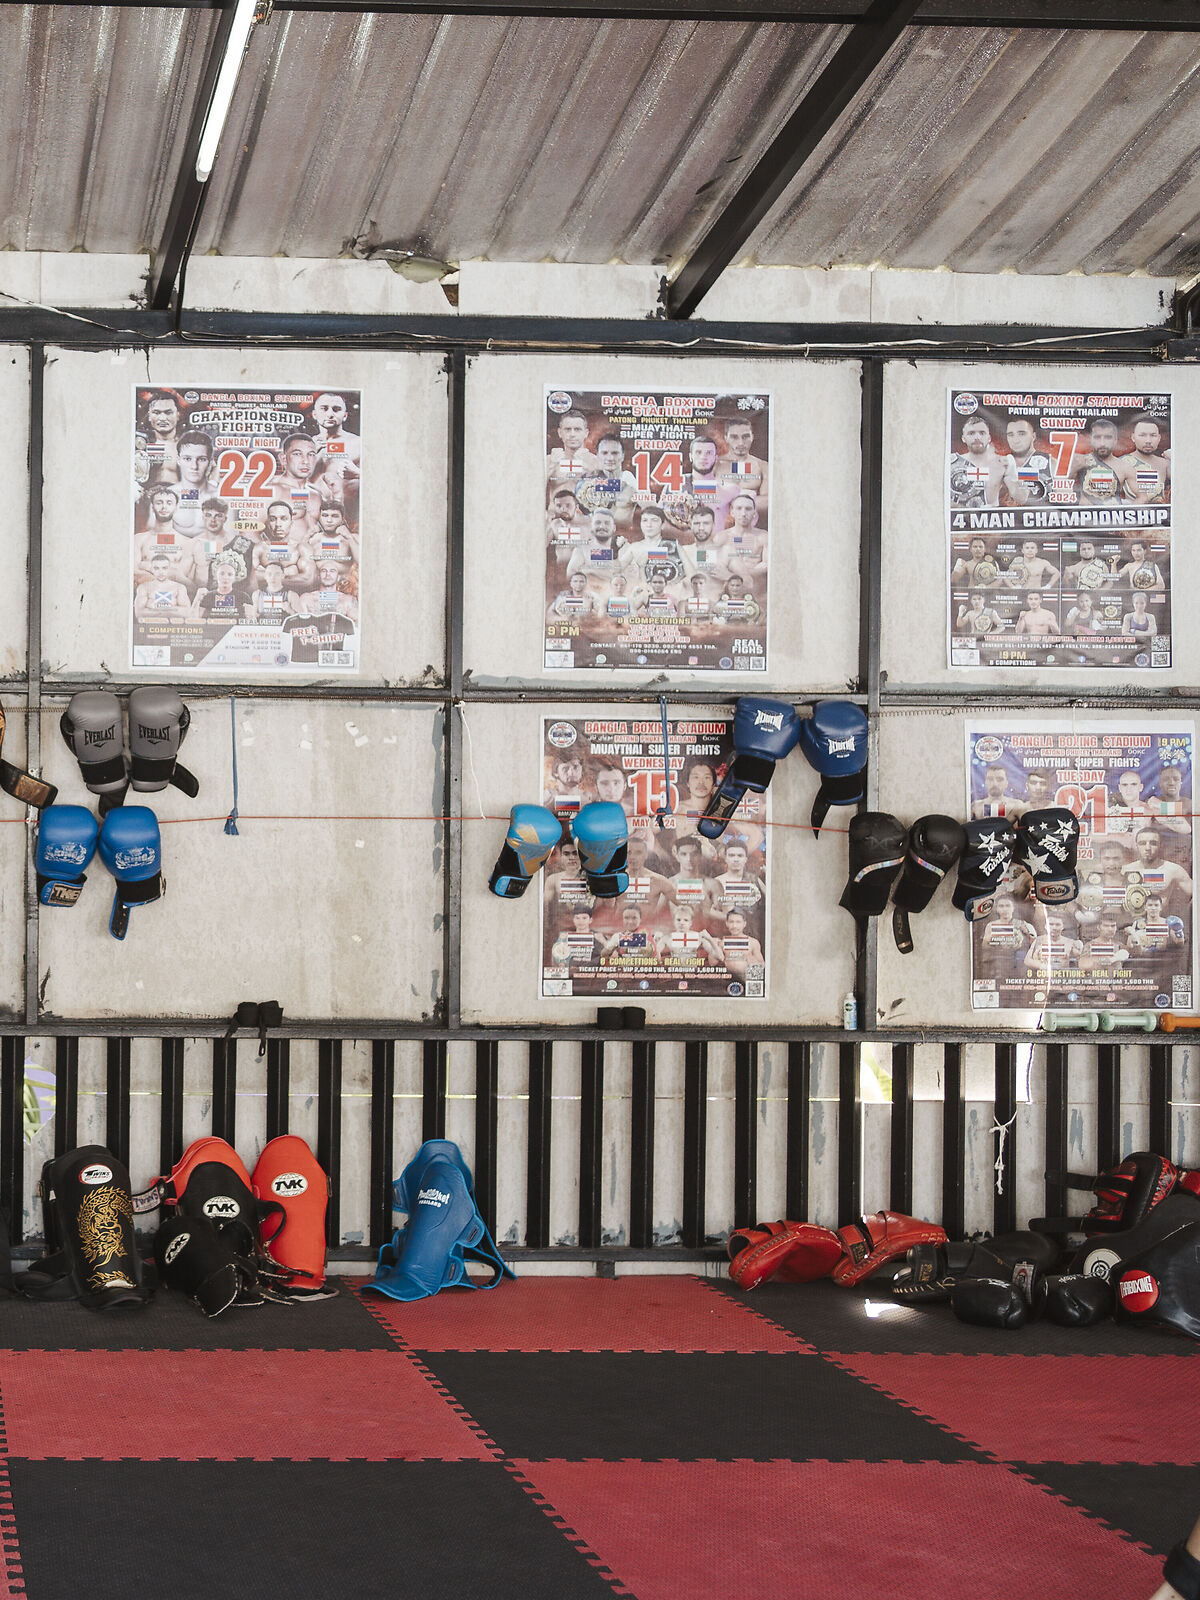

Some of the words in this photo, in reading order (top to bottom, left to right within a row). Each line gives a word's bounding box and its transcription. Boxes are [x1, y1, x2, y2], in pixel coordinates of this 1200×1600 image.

[201, 393, 236, 402] BANGLA
[238, 394, 271, 402] BOXING
[275, 395, 314, 403] STADIUM
[602, 396, 656, 406] BANGLA
[664, 398, 715, 408] BOXING
[984, 394, 1032, 406] BANGLA
[1038, 396, 1084, 406] BOXING
[1088, 396, 1143, 407] STADIUM
[633, 407, 692, 416] STADIUM
[1008, 408, 1040, 416] PATONG
[1043, 408, 1076, 416] PHUKET
[1077, 408, 1118, 416] THAILAND
[191, 410, 303, 425] CHAMPIONSHIP
[221, 422, 272, 432] FIGHTS
[632, 424, 684, 432] MUAYTHAI
[1041, 418, 1086, 428] SUNDAY
[216, 437, 250, 447] SUNDAY
[254, 438, 280, 448] NIGHT
[636, 440, 681, 450] FRIDAY
[1050, 432, 1077, 477] 7
[220, 453, 273, 497] 22
[632, 453, 683, 491] 14
[1052, 479, 1074, 488] JULY
[633, 494, 654, 502] JUNE
[1050, 493, 1076, 502] 2024
[953, 514, 966, 528] 4
[970, 512, 1015, 528] MAN
[1023, 510, 1168, 527] CHAMPIONSHIP
[245, 522, 258, 530] PM
[290, 627, 316, 636] FREE
[548, 626, 555, 636] 9
[560, 626, 580, 636] PM
[301, 634, 344, 646] T-SHIRT
[1011, 651, 1026, 660] PM
[138, 724, 170, 741] EVERLAST
[585, 722, 627, 734] BANGLA
[678, 722, 726, 734] STADIUM
[84, 724, 116, 746] EVERLAST
[1012, 736, 1053, 747] BANGLA
[1103, 736, 1150, 747] STADIUM
[1170, 738, 1186, 746] PM
[590, 744, 642, 754] MUAYTHAI
[686, 745, 720, 755] FIGHTS
[624, 758, 684, 768] WEDNESAY
[1023, 758, 1070, 767] MUAYTHAI
[1074, 758, 1104, 767] SUPER
[1109, 758, 1140, 768] FIGHTS
[1057, 771, 1104, 782] TUESDAY
[631, 772, 678, 816] 15
[632, 818, 650, 828] MAY
[654, 818, 676, 828] 224
[1077, 838, 1091, 846] AY
[1077, 849, 1094, 858] 24
[664, 958, 682, 966] REAL
[686, 958, 705, 966] FIGHT
[1092, 970, 1108, 978] REAL
[1113, 970, 1132, 978] FIGHT
[274, 1179, 304, 1192] TVK
[134, 1188, 159, 1208] TWINS
[207, 1202, 237, 1214] TVK
[166, 1234, 187, 1261] TVK
